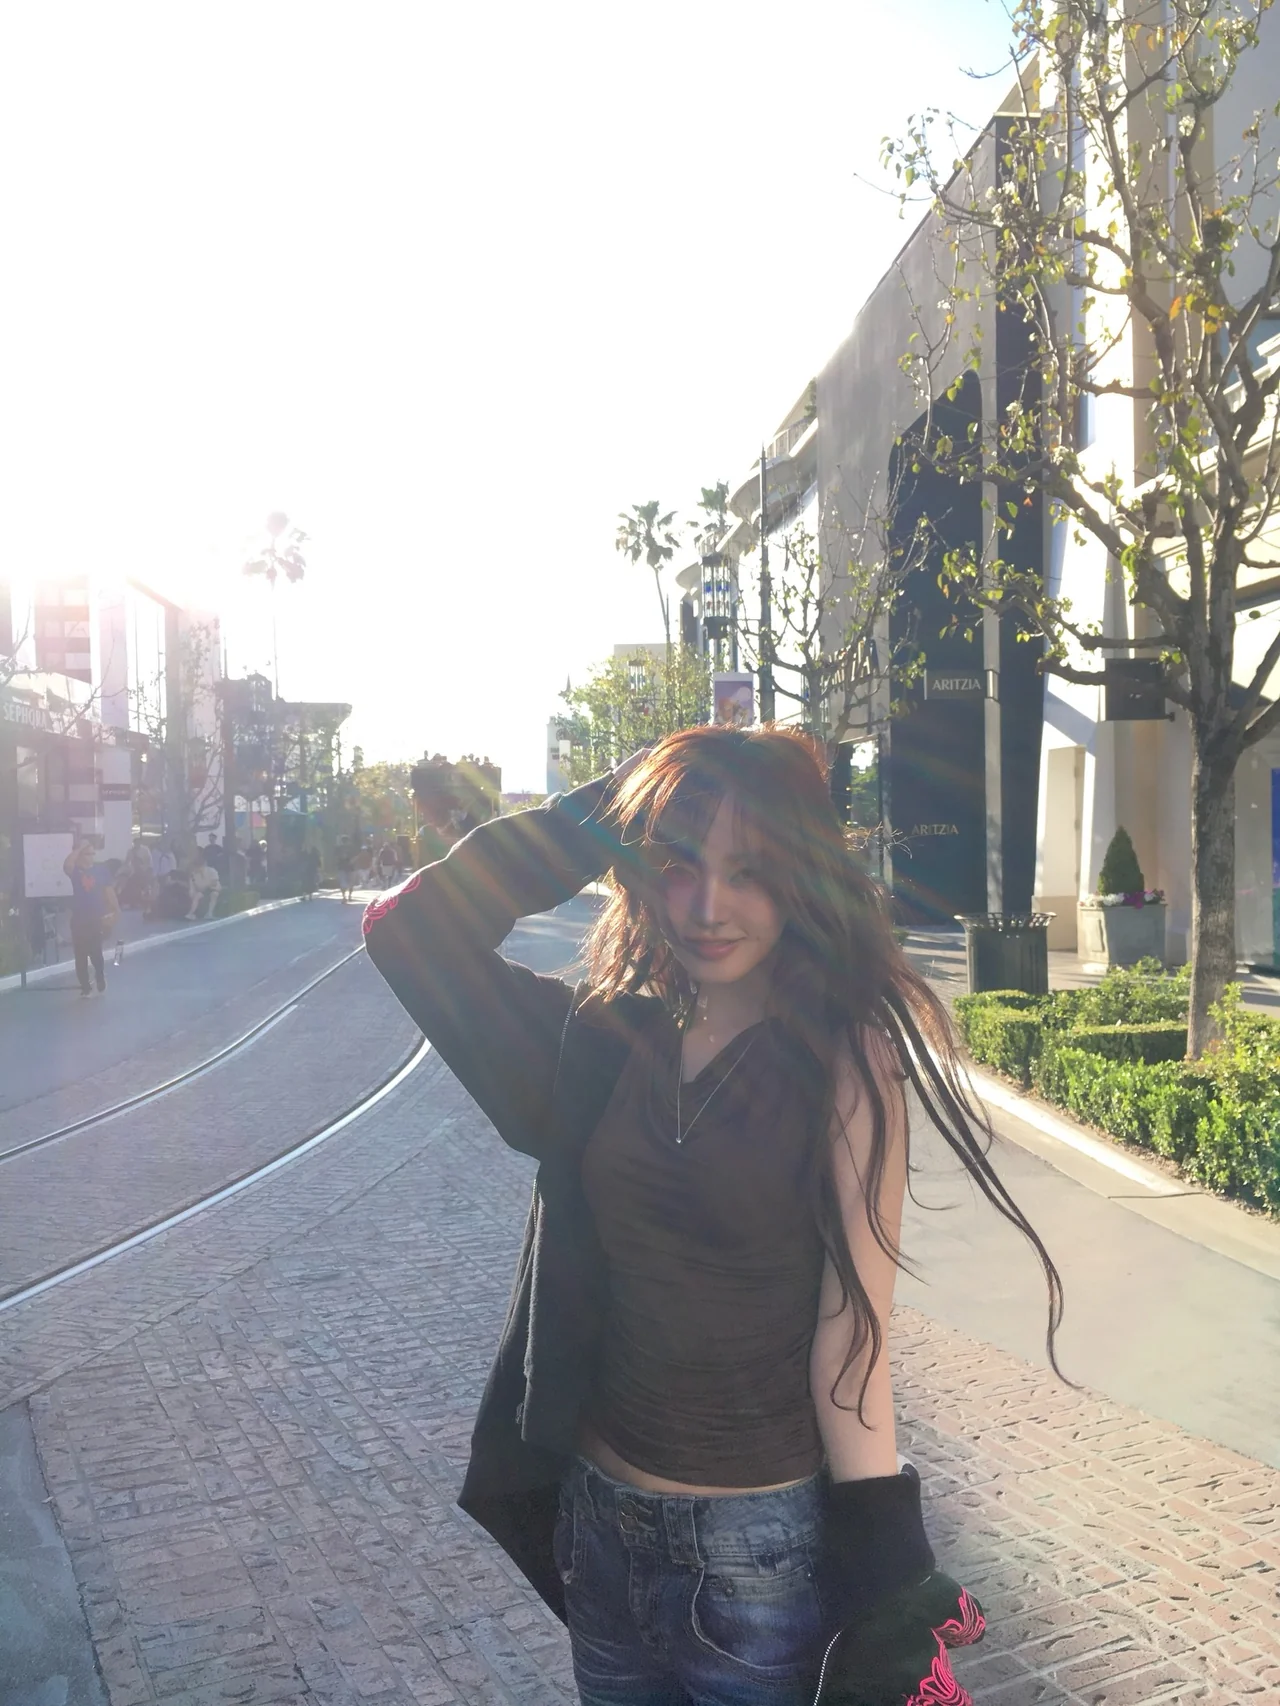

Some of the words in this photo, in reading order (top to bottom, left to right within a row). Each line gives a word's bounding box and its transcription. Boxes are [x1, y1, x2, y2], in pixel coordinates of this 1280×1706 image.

[932, 678, 982, 691] ARITZIA
[3, 702, 47, 729] SEPHORA
[911, 824, 959, 835] ARITZIA
